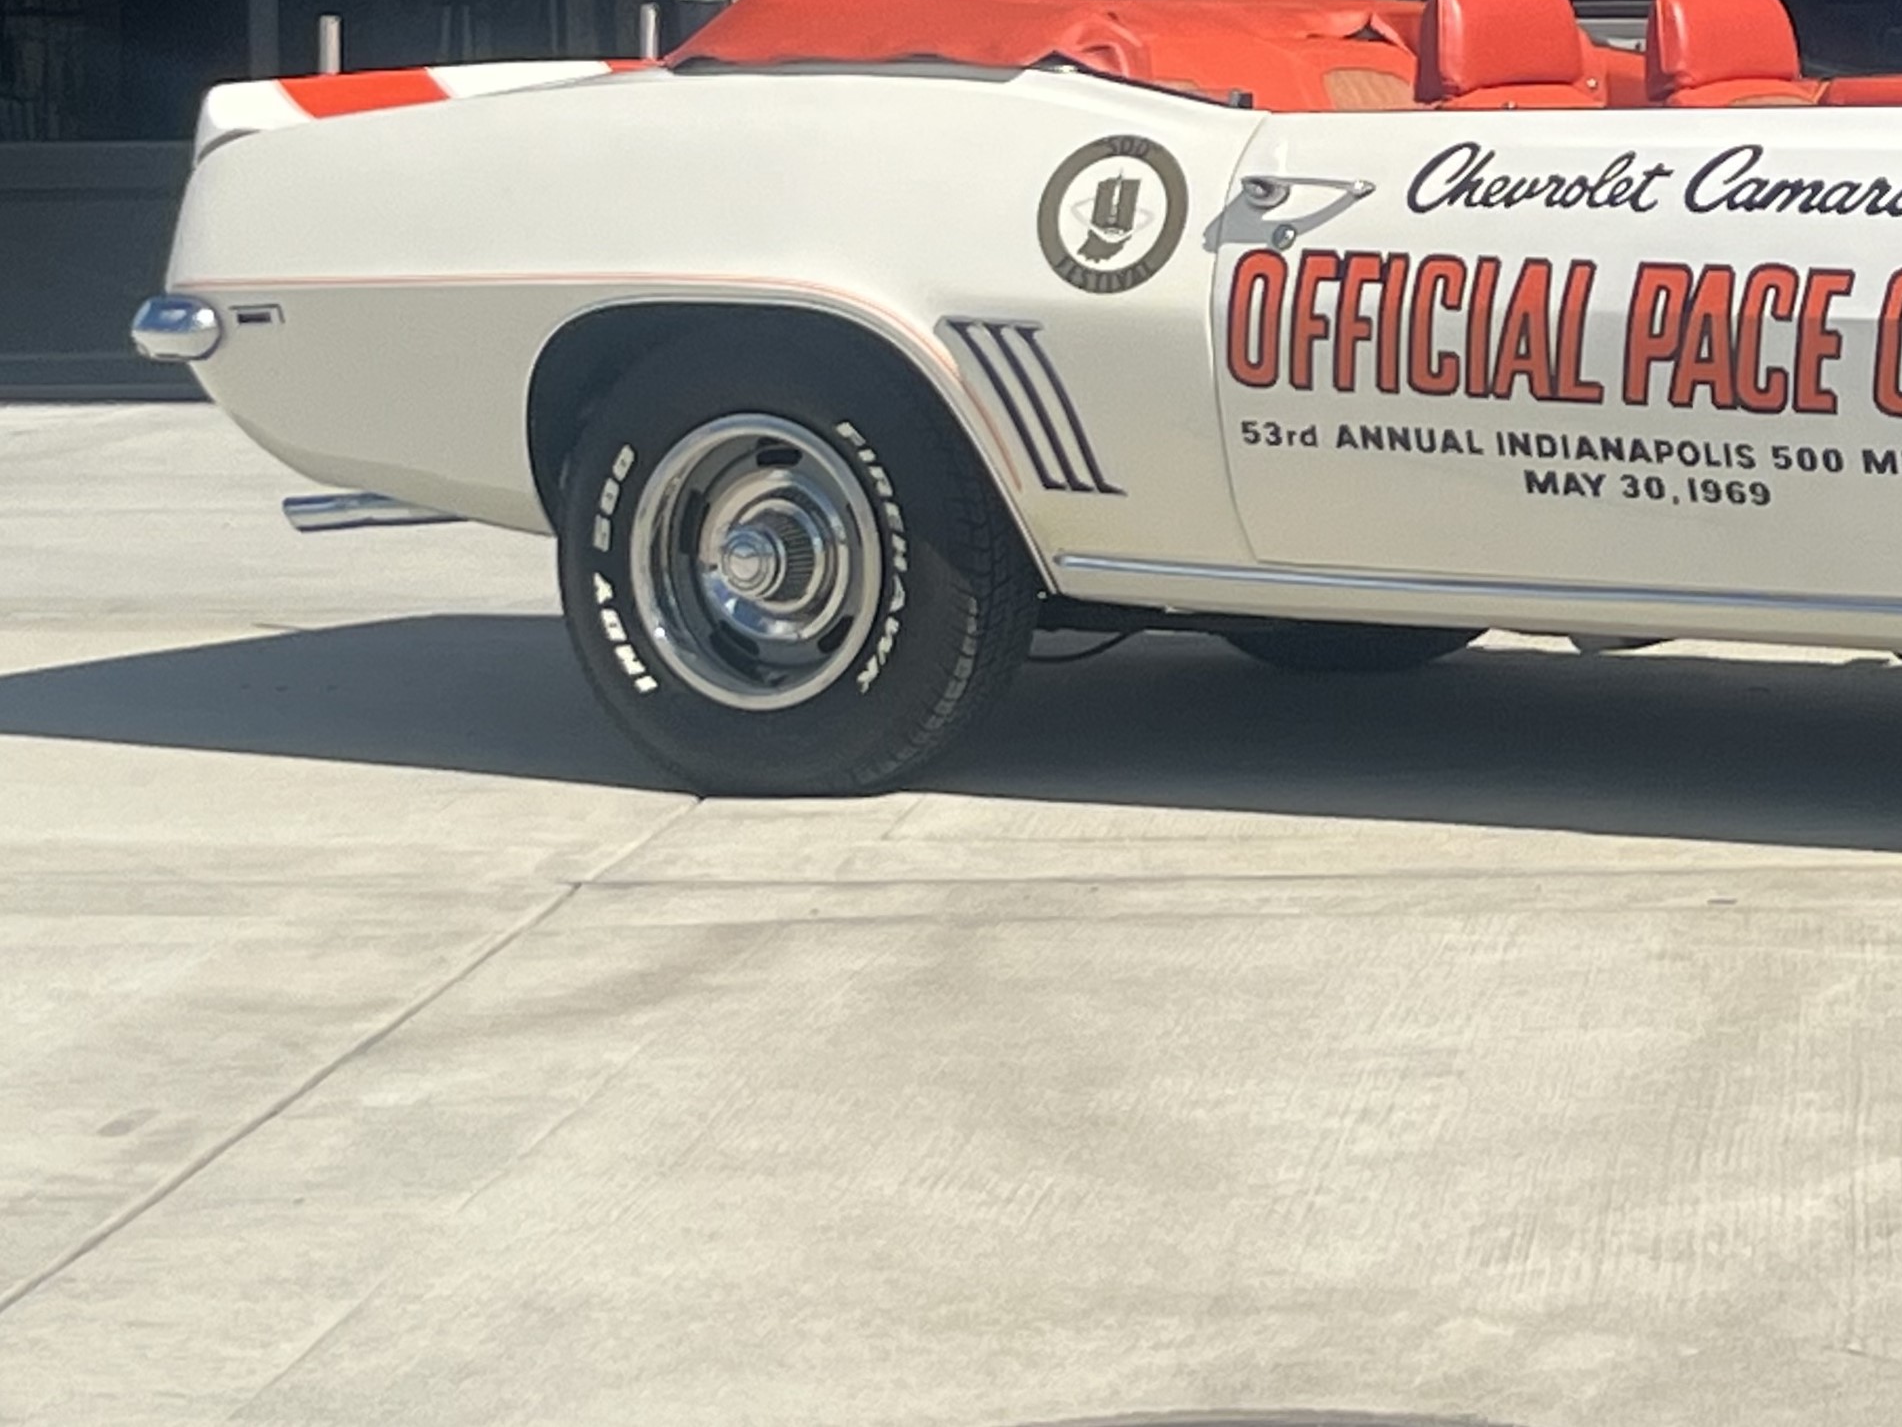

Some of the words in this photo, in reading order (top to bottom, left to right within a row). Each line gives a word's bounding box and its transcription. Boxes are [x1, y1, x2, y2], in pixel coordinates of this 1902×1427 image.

[1407, 141, 1674, 213] Chevrolet
[1227, 248, 1604, 404] OFFICIAL
[1622, 261, 1855, 415] PACE
[1241, 421, 1318, 448] 53rd
[1336, 424, 1484, 455] ANNUAL
[1497, 431, 1756, 470] INDIANAPOLIS
[1771, 445, 1844, 473] 500
[1523, 470, 1605, 497] MAY
[593, 444, 636, 552] 500
[836, 421, 908, 693] FIREHAWK
